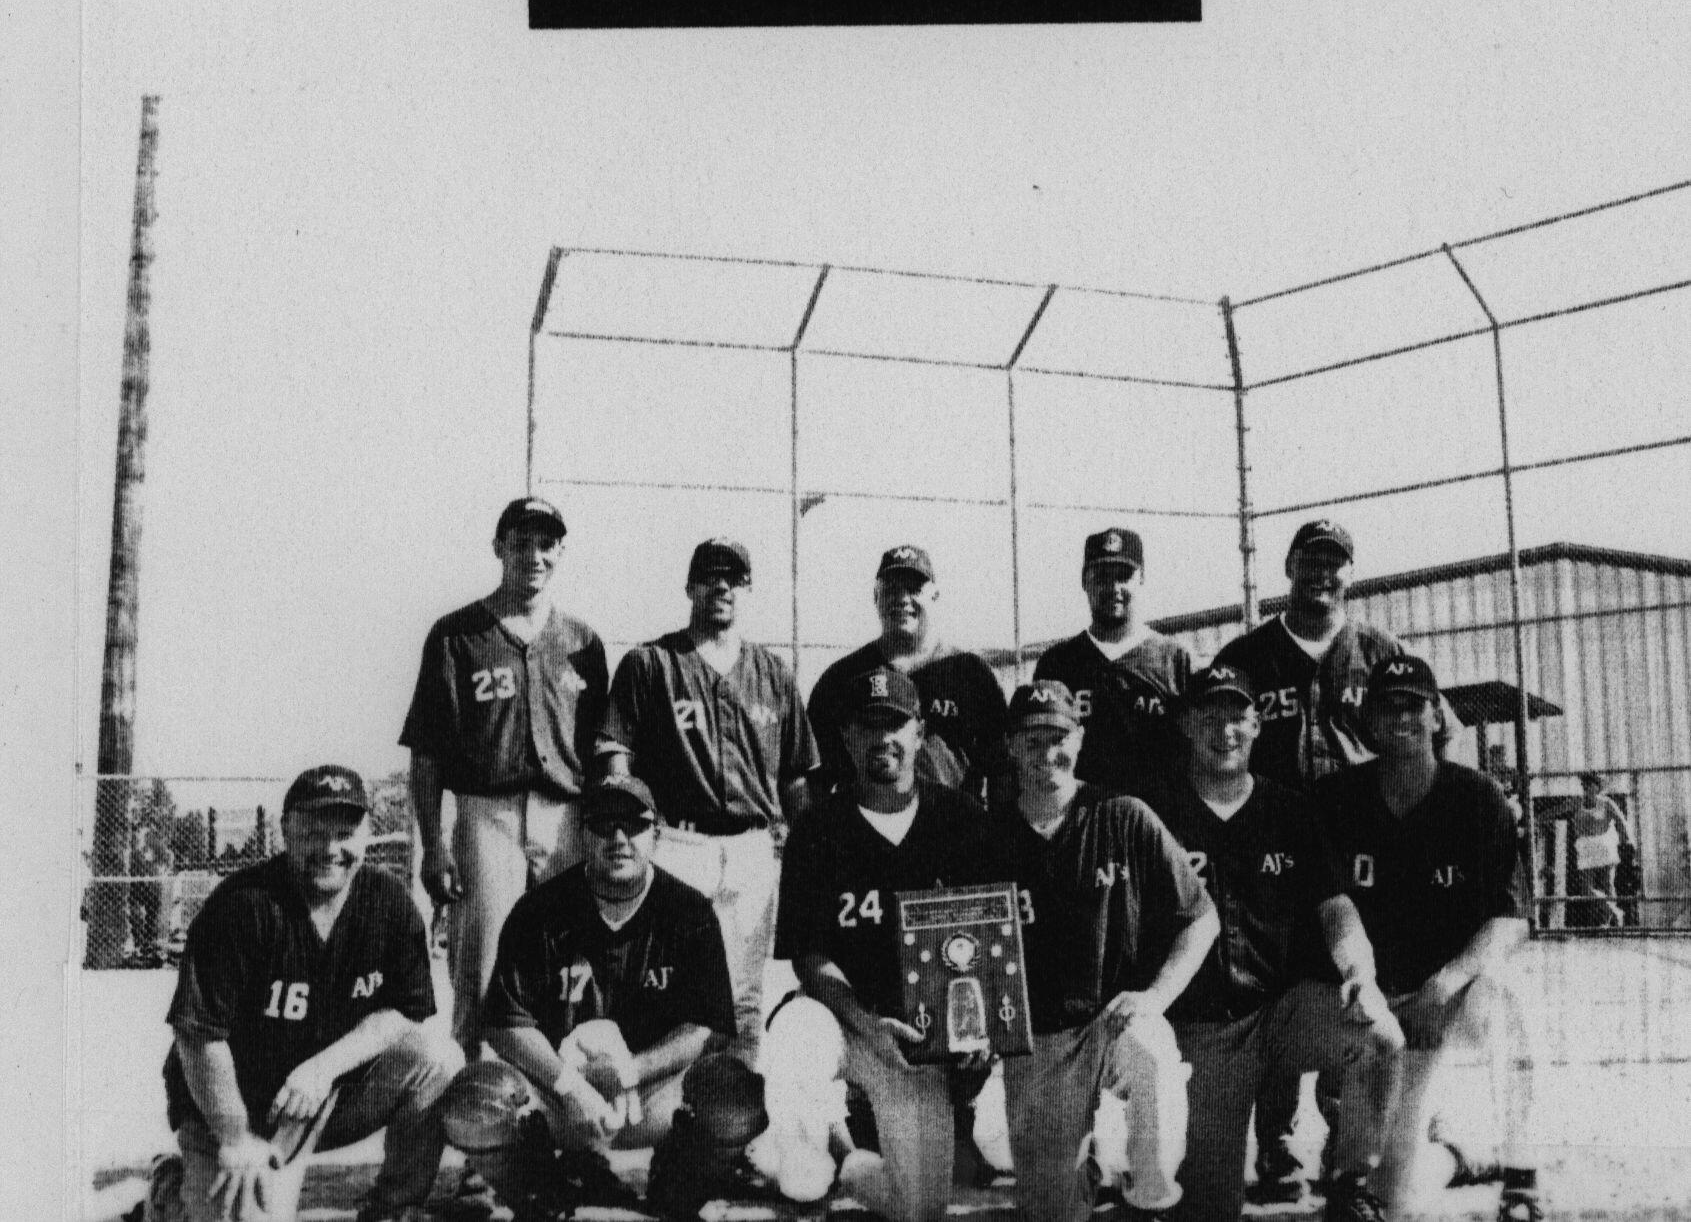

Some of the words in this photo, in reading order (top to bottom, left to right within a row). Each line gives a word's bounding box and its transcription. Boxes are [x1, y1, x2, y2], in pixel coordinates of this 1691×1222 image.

[471, 666, 516, 702] 23
[1258, 686, 1299, 722] 25
[1260, 852, 1295, 876] AJ's
[838, 889, 883, 928] 24
[263, 979, 310, 1021] 16
[559, 960, 593, 1003] 17
